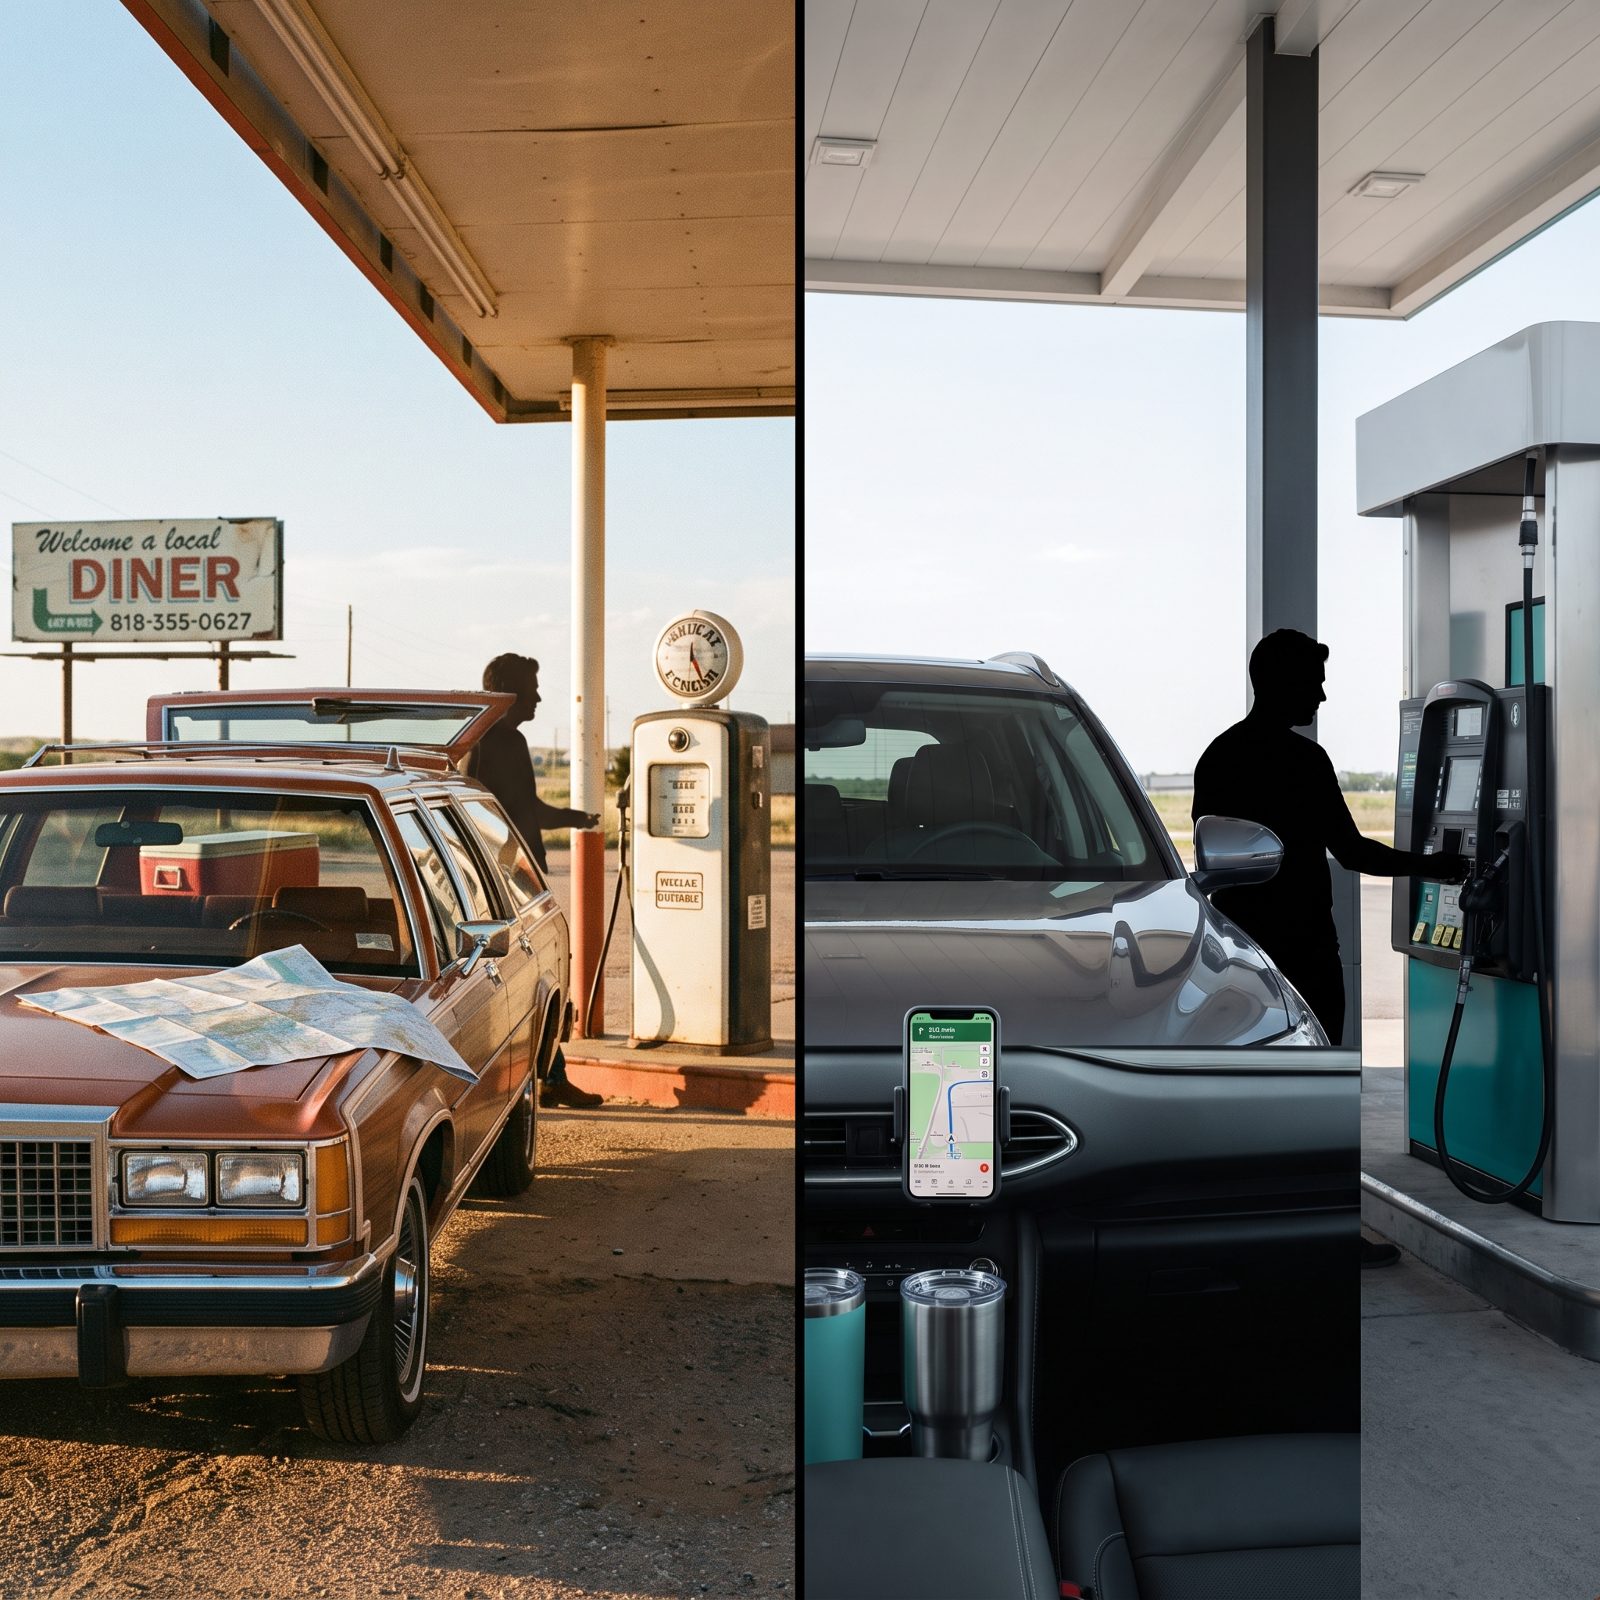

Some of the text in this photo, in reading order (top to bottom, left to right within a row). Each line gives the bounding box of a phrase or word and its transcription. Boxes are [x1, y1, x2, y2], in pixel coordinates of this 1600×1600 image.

[36, 526, 222, 553] Welcome a local
[69, 556, 240, 603] DINER
[111, 612, 251, 631] 818-355-0627
